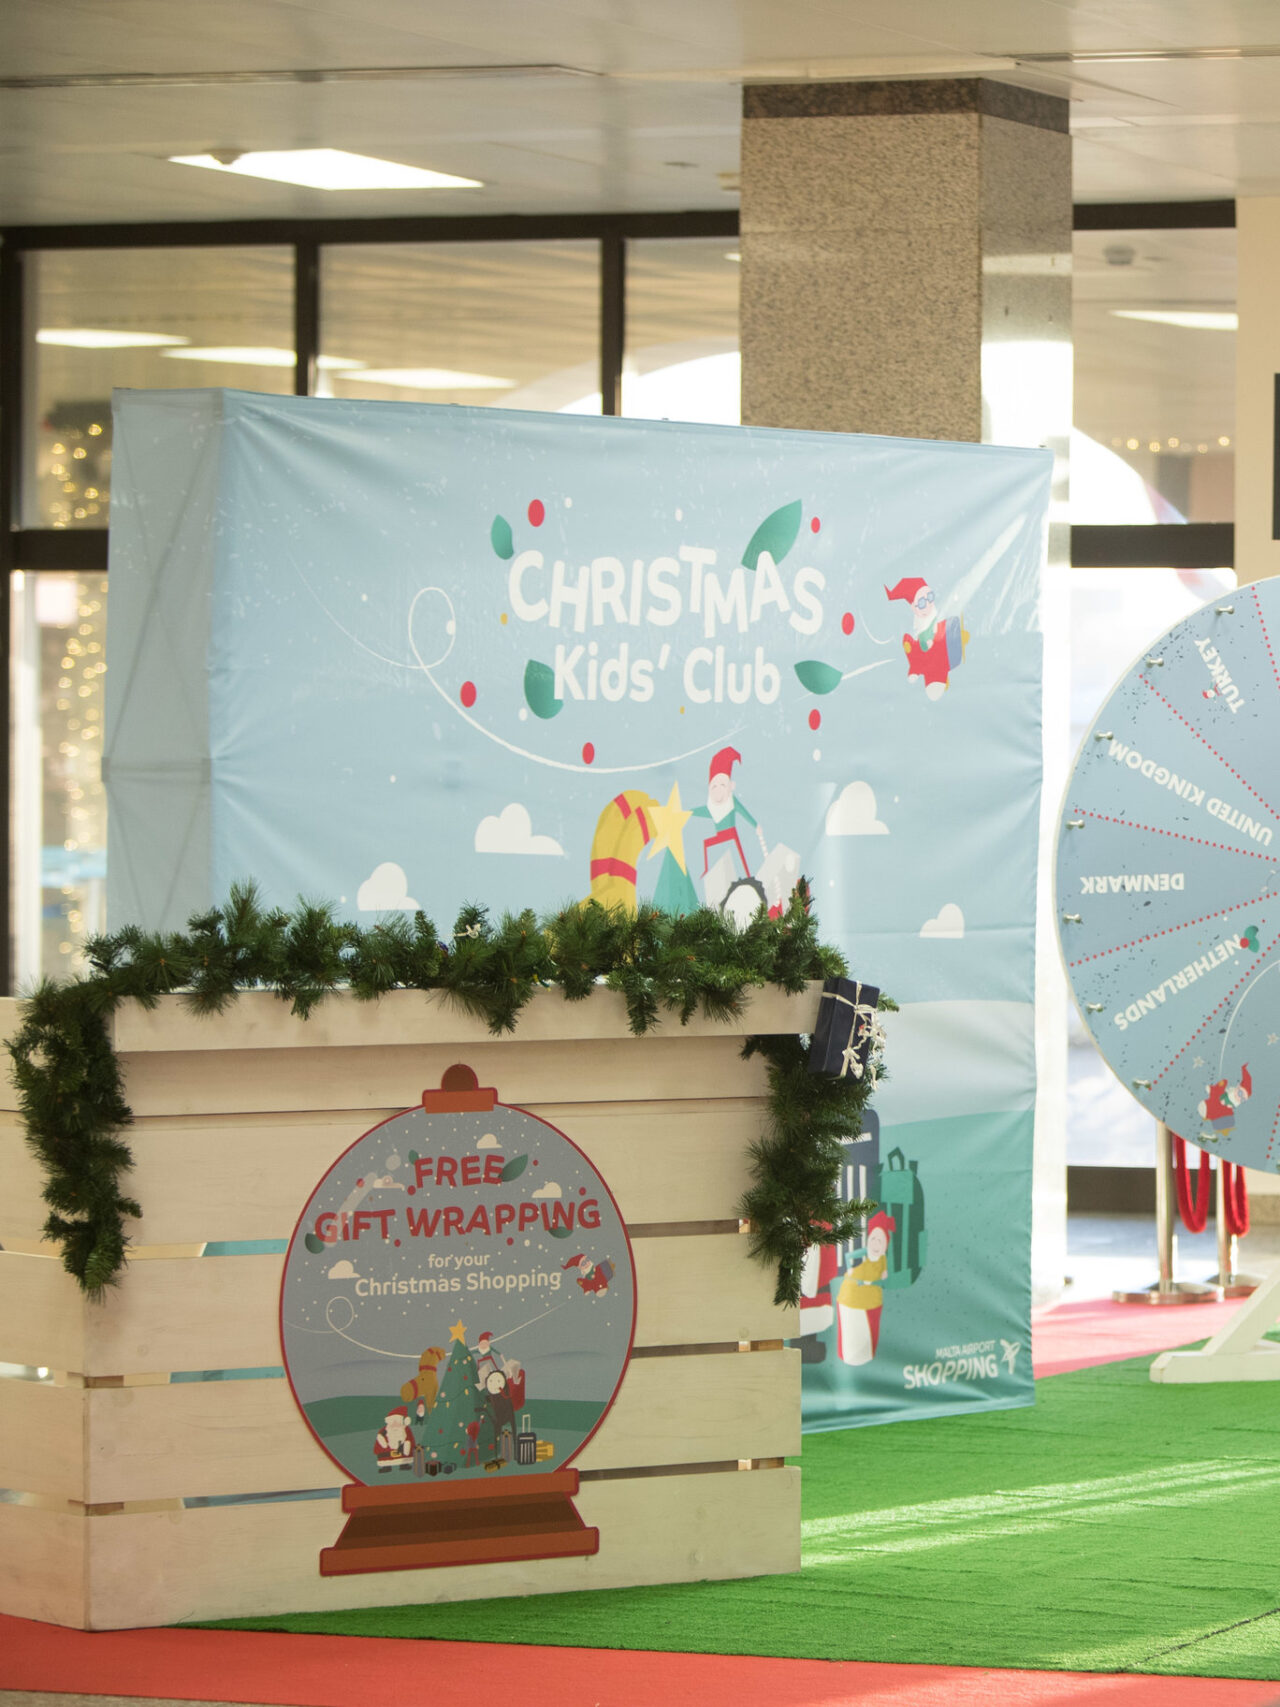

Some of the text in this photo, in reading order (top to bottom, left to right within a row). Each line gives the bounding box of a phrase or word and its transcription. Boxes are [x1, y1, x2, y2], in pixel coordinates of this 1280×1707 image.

[508, 545, 827, 638] CHRISTMAS
[554, 642, 782, 704] Kids' Club
[1194, 638, 1246, 715] TURKEY
[1108, 739, 1274, 846] UNITED KINGDOM
[1080, 873, 1185, 894] DENMARK
[1113, 932, 1242, 1031] NETHERLANDS
[414, 1155, 506, 1189] FREE
[314, 1199, 602, 1243] GIFT WRAPPING
[428, 1254, 491, 1270] for your
[355, 1271, 563, 1297] Christmas Shopping
[903, 1354, 998, 1390] SHOPPING
[935, 1345, 960, 1359] MALTA
